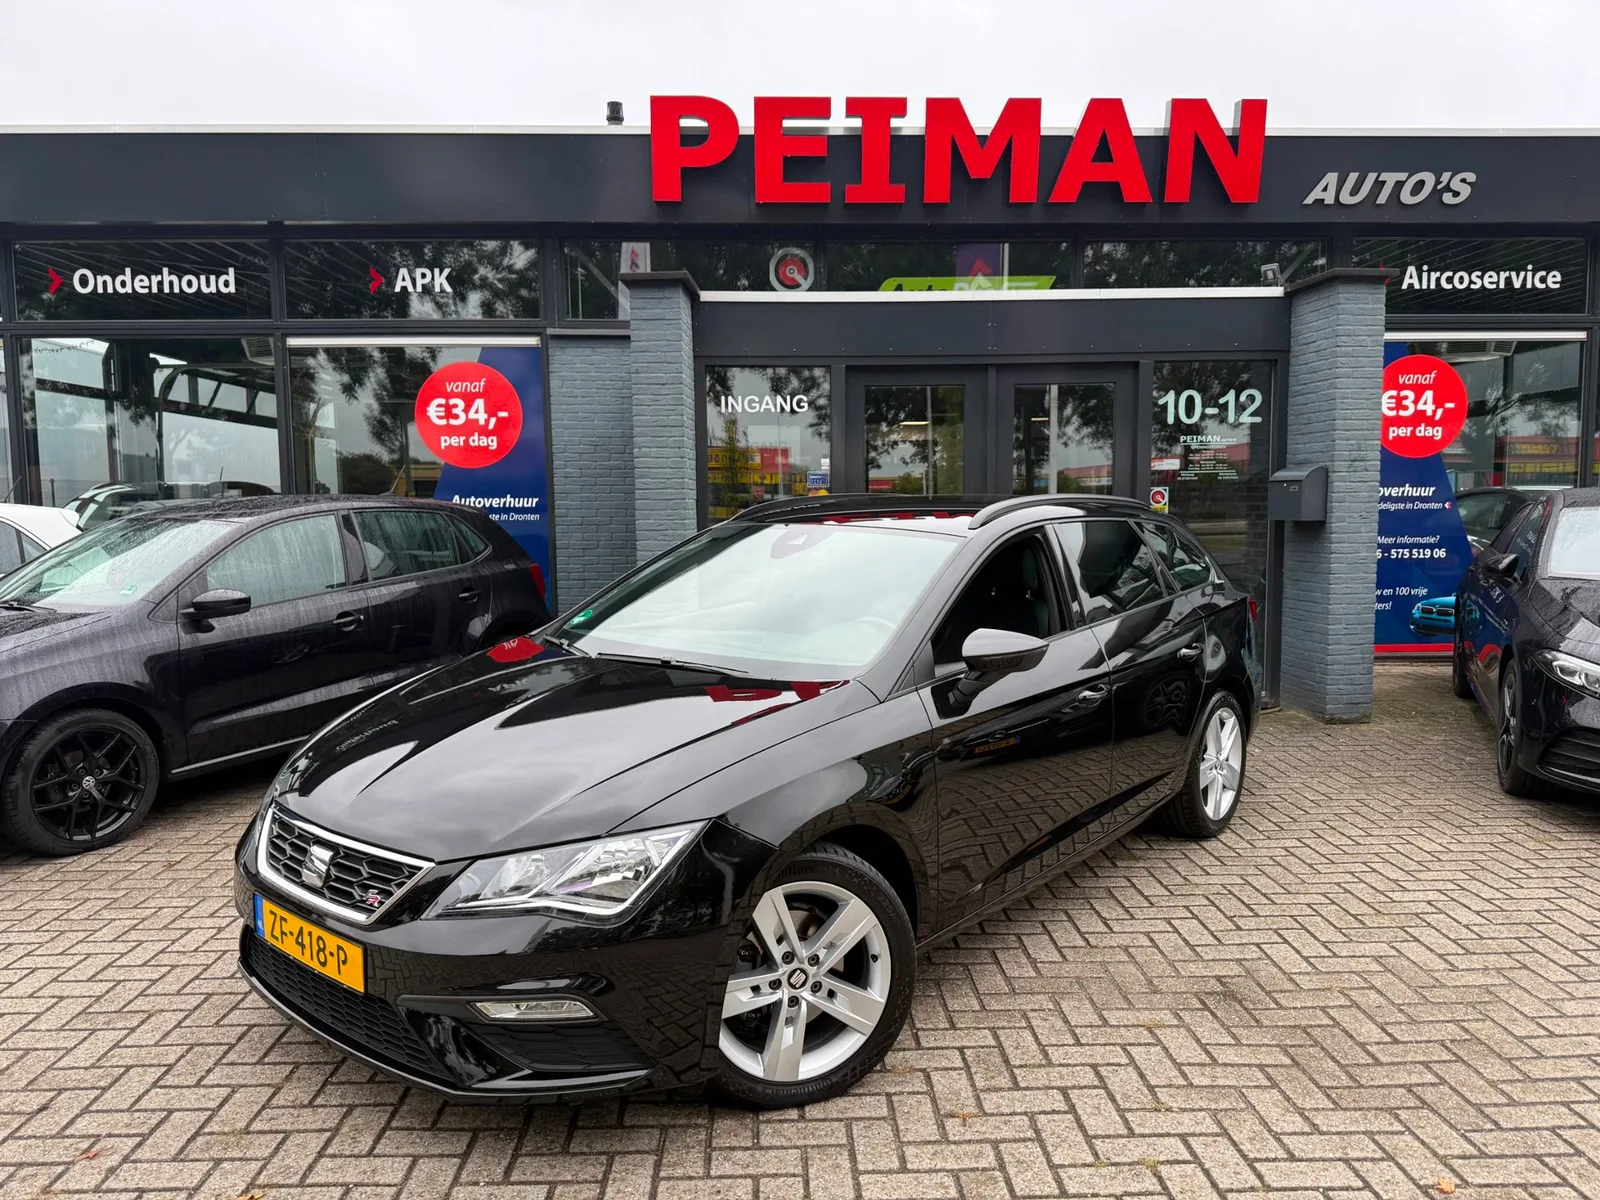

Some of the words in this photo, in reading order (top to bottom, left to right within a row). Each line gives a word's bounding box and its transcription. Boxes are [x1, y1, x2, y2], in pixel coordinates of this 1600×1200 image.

[650, 95, 1268, 204] PEIMAN
[72, 267, 236, 294] Onderhoud
[394, 267, 453, 293] APK
[1401, 264, 1562, 290] Aircoservice
[446, 378, 486, 393] vanaf
[1398, 370, 1438, 385] vanaf
[720, 394, 809, 414] INGANG
[1157, 388, 1263, 425] 10-12
[1381, 389, 1456, 421] €34,-
[426, 397, 509, 430] €34,-
[1180, 434, 1221, 443] PEIMAN
[1388, 425, 1412, 440] per
[1415, 423, 1443, 440] dag
[440, 435, 466, 450] per
[468, 432, 498, 450] dag
[1405, 501, 1413, 510] in
[1413, 501, 1443, 510] Dronten
[500, 512, 508, 521] in
[509, 512, 540, 521] Dronten
[1396, 534, 1440, 544] informatie?
[1390, 548, 1410, 559] 575
[1411, 548, 1431, 559] 519
[1432, 548, 1447, 559] 06
[1383, 588, 1393, 596] en
[1395, 586, 1410, 596] 100
[1410, 587, 1428, 597] vrije
[268, 909, 348, 976] ZF-418-P
